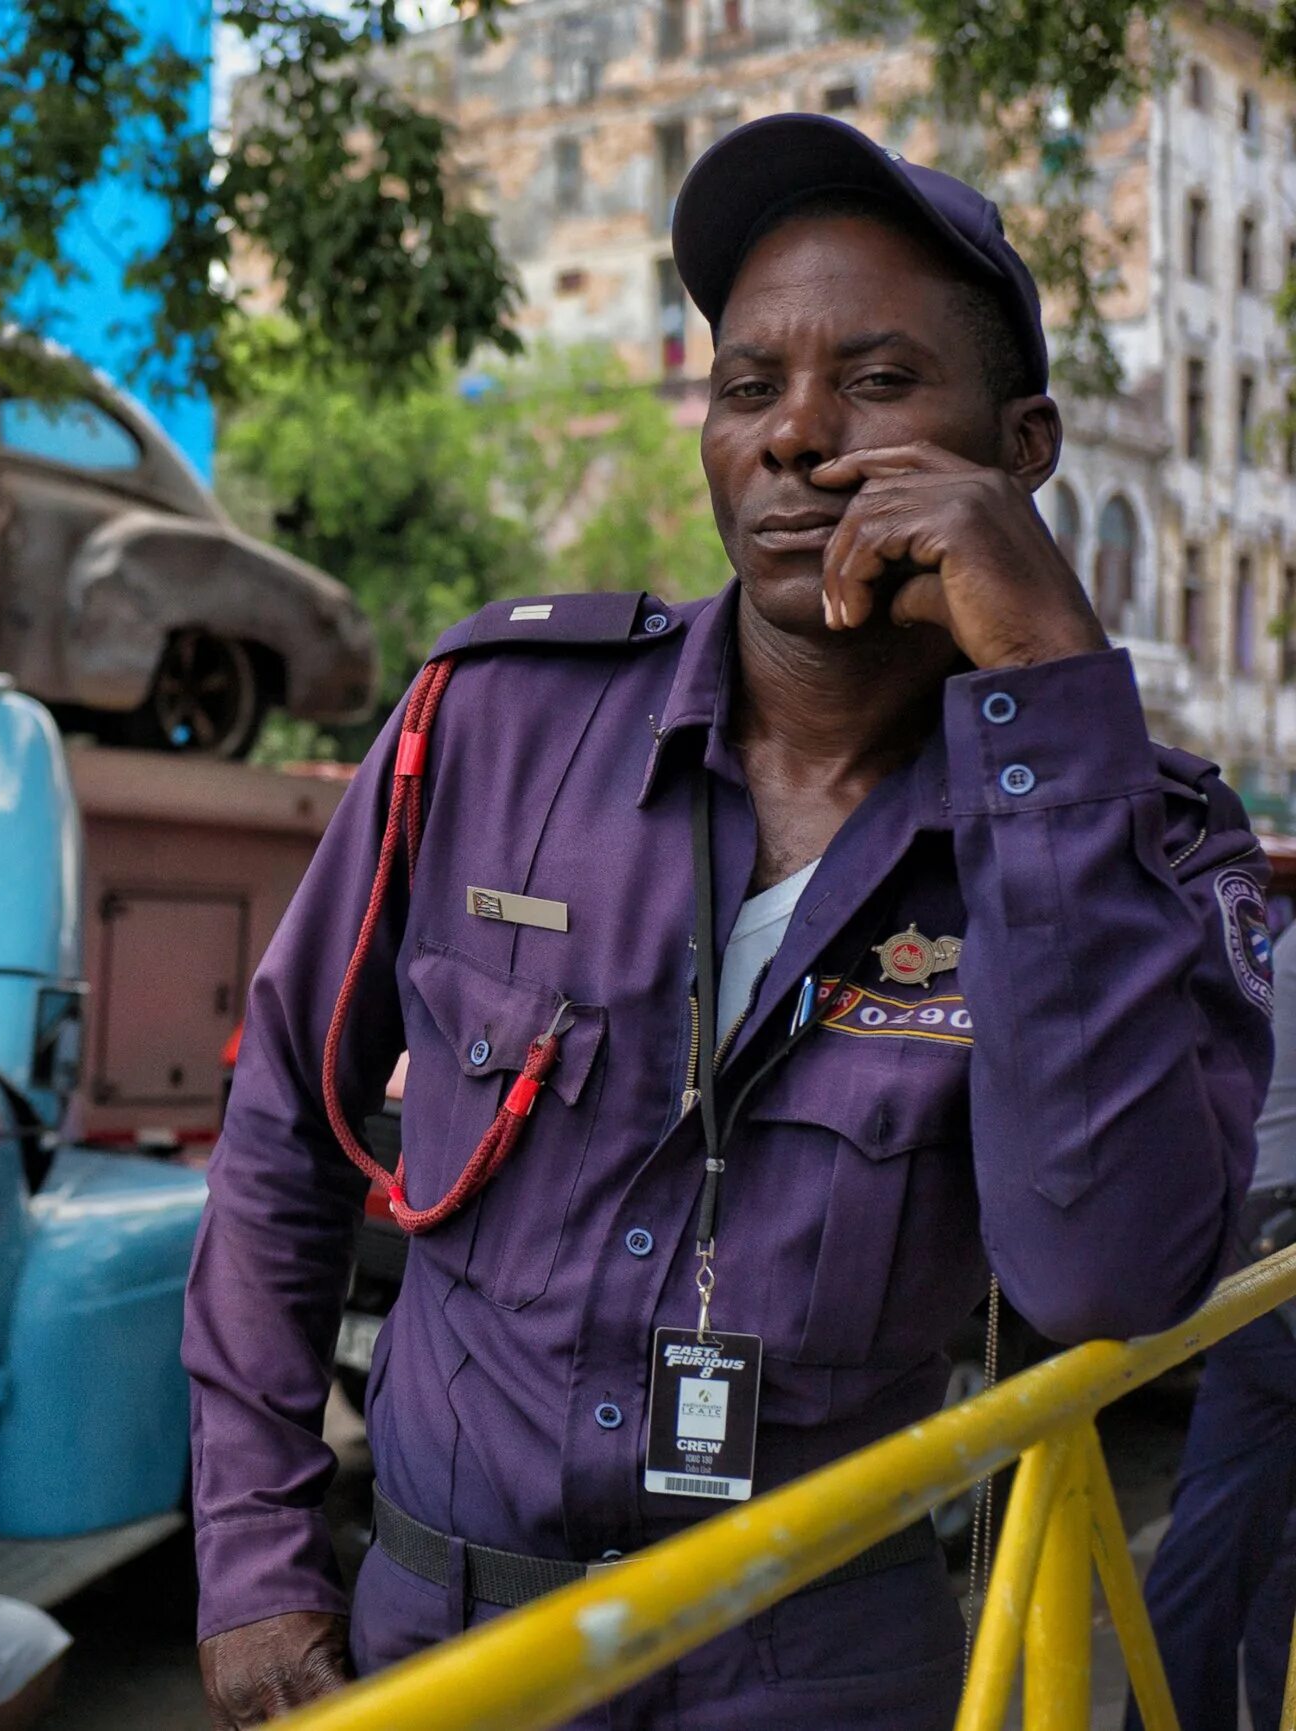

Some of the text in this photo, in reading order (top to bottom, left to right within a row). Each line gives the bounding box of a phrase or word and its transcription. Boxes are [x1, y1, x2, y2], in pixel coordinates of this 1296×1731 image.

[818, 987, 852, 1008] PR
[666, 1354, 746, 1370] FURIOUS
[699, 1366, 714, 1379] 8
[682, 1406, 721, 1416] ICAIC
[676, 1439, 722, 1454] CREW
